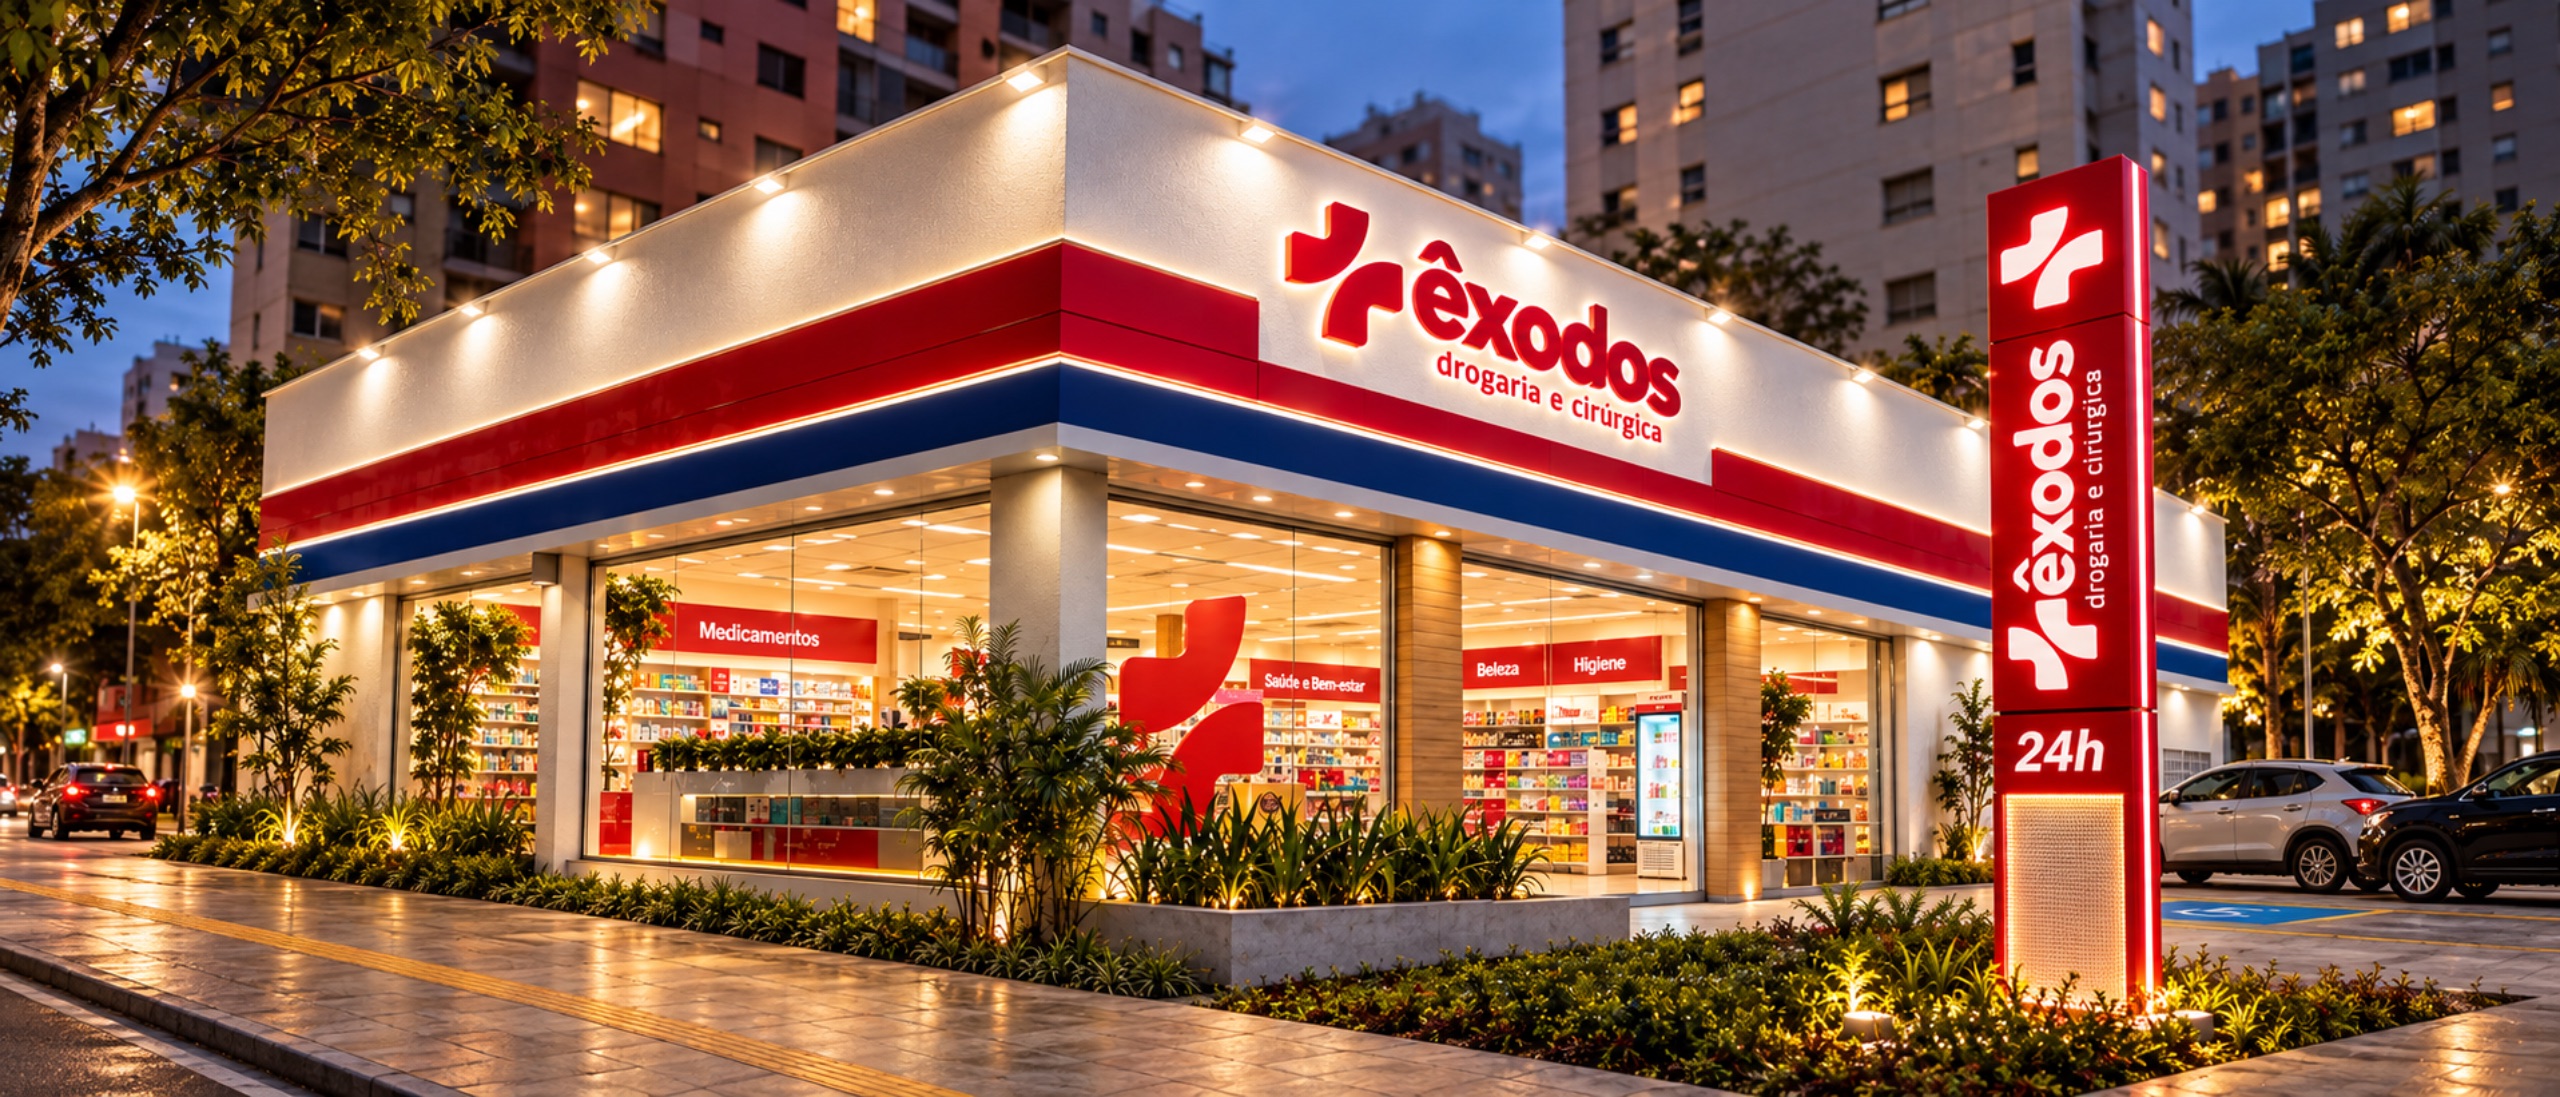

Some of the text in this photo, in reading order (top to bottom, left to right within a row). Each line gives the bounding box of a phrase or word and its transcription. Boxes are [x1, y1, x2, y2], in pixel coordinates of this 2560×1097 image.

[1412, 240, 1682, 417] êxodos
[1437, 351, 1662, 443] drogaria e cirúrgica
[2013, 340, 2075, 596] êxodos
[2088, 485, 2103, 499] e
[2084, 508, 2109, 609] drogaria
[699, 620, 820, 647] Medicamentos
[1264, 673, 1366, 693] Saúde e Bem-estar
[1476, 662, 1519, 677] Beleza
[1573, 656, 1626, 675] Higiene
[2014, 728, 2105, 773] 24h
